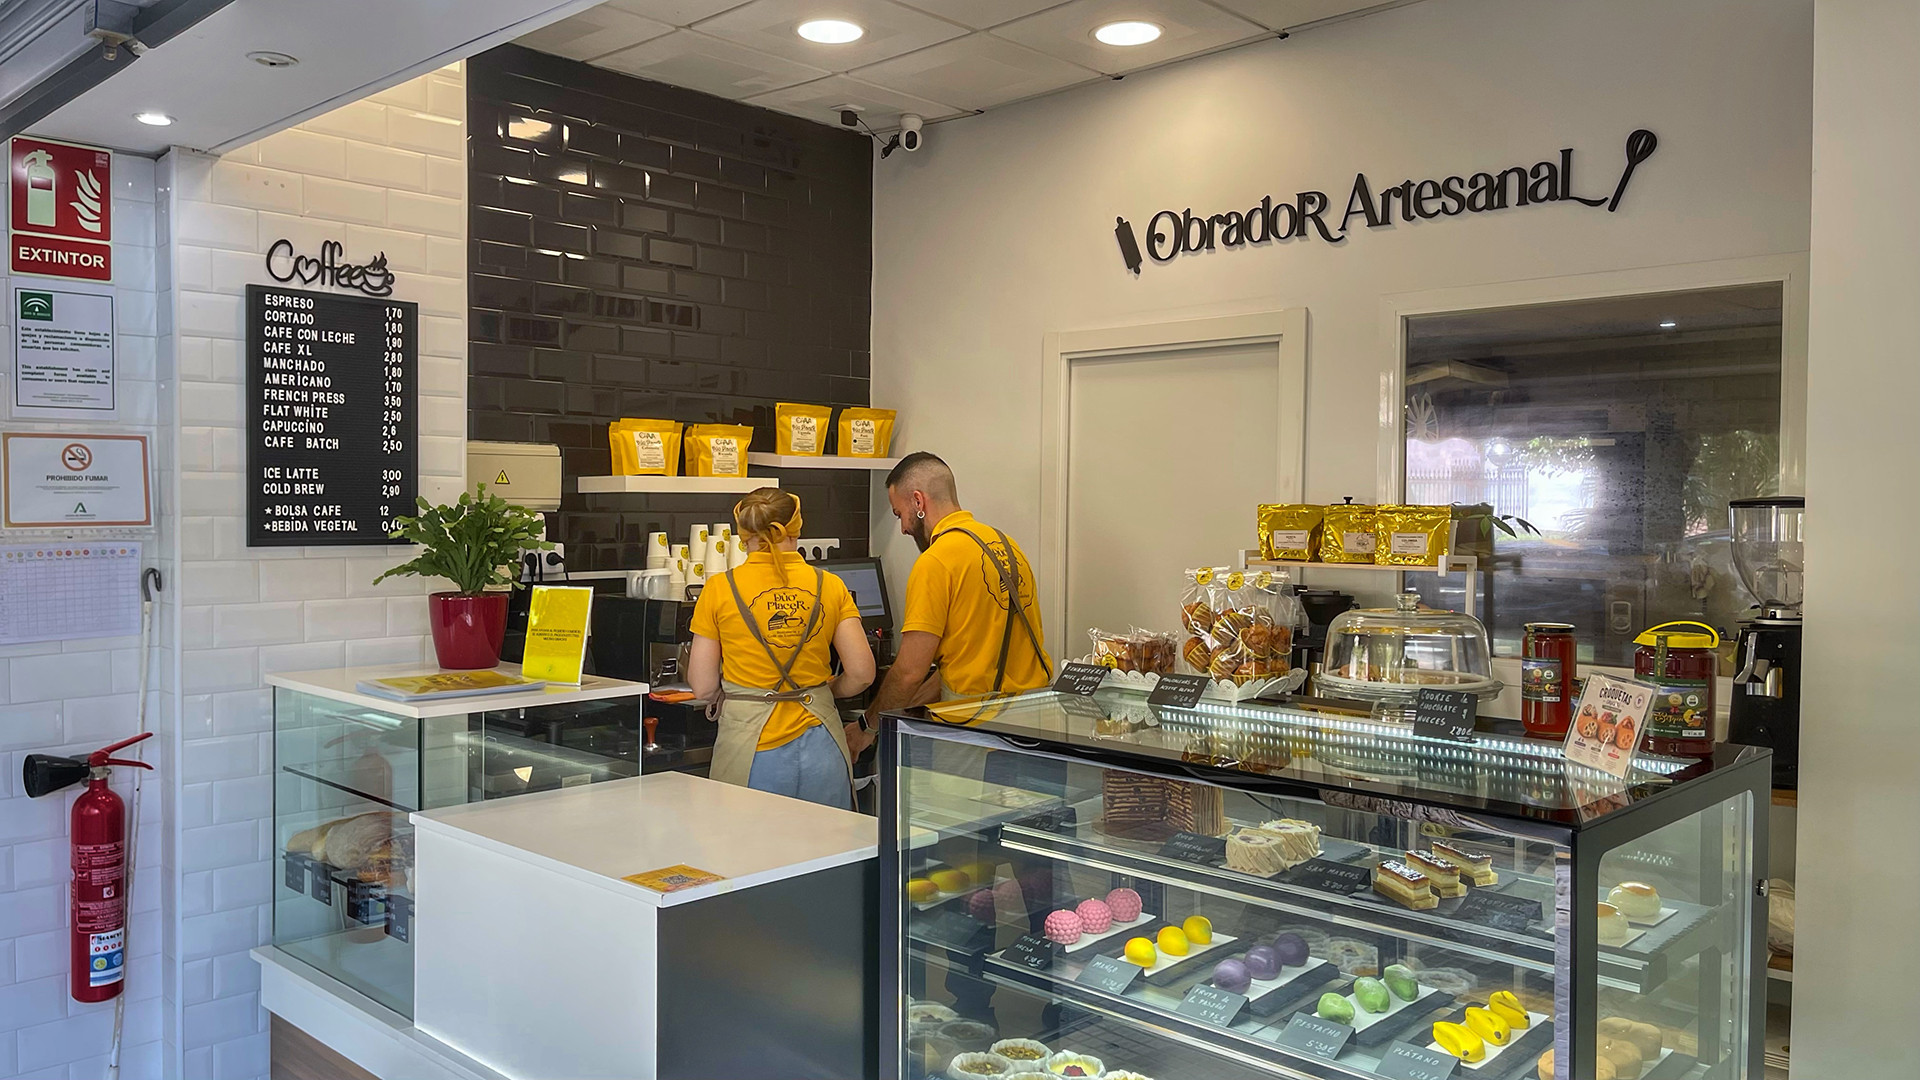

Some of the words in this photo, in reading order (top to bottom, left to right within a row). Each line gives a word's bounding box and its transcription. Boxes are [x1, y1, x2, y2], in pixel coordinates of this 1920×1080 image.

[19, 247, 105, 268] EXTINTOR
[265, 294, 314, 309] ESPRESO
[385, 307, 403, 321] 1,70
[265, 310, 314, 325] CORTADO
[384, 322, 403, 336] 1,80
[264, 326, 293, 339] CAFE
[297, 329, 318, 342] CON
[322, 332, 356, 345] LECHE
[385, 337, 403, 351] 1,90
[263, 341, 292, 355] CAFE
[297, 344, 313, 356] XL
[384, 353, 403, 366] 2,80
[263, 357, 326, 372] MANCHADO
[384, 367, 402, 380] 1,80
[264, 389, 309, 403] FRENCH
[312, 391, 346, 405] PRESS
[263, 404, 290, 417] FLAT
[383, 411, 402, 425] 2,50
[382, 426, 397, 439] 2,6
[264, 436, 294, 448] CAFE
[306, 438, 340, 450] BATCH
[382, 441, 403, 454] 2,50
[263, 467, 281, 479] ICE
[286, 468, 319, 480] LATTE
[263, 483, 291, 495] COLD
[294, 484, 325, 495] BREW
[382, 485, 400, 499] 2,90
[275, 505, 309, 517] BOLSA
[313, 505, 342, 517] CAFE
[379, 506, 389, 516] 12
[314, 520, 358, 532] VEGETAL
[1421, 690, 1453, 703] COOKIE
[1599, 687, 1633, 706] CROQUETAS
[1419, 702, 1458, 714] CHOCOLATE
[1416, 714, 1446, 726] NUECES
[1305, 863, 1327, 875] SAN
[1329, 867, 1361, 881] MARCOS
[1193, 987, 1218, 1001] FRUTA
[1293, 1017, 1342, 1038] PISTACHO
